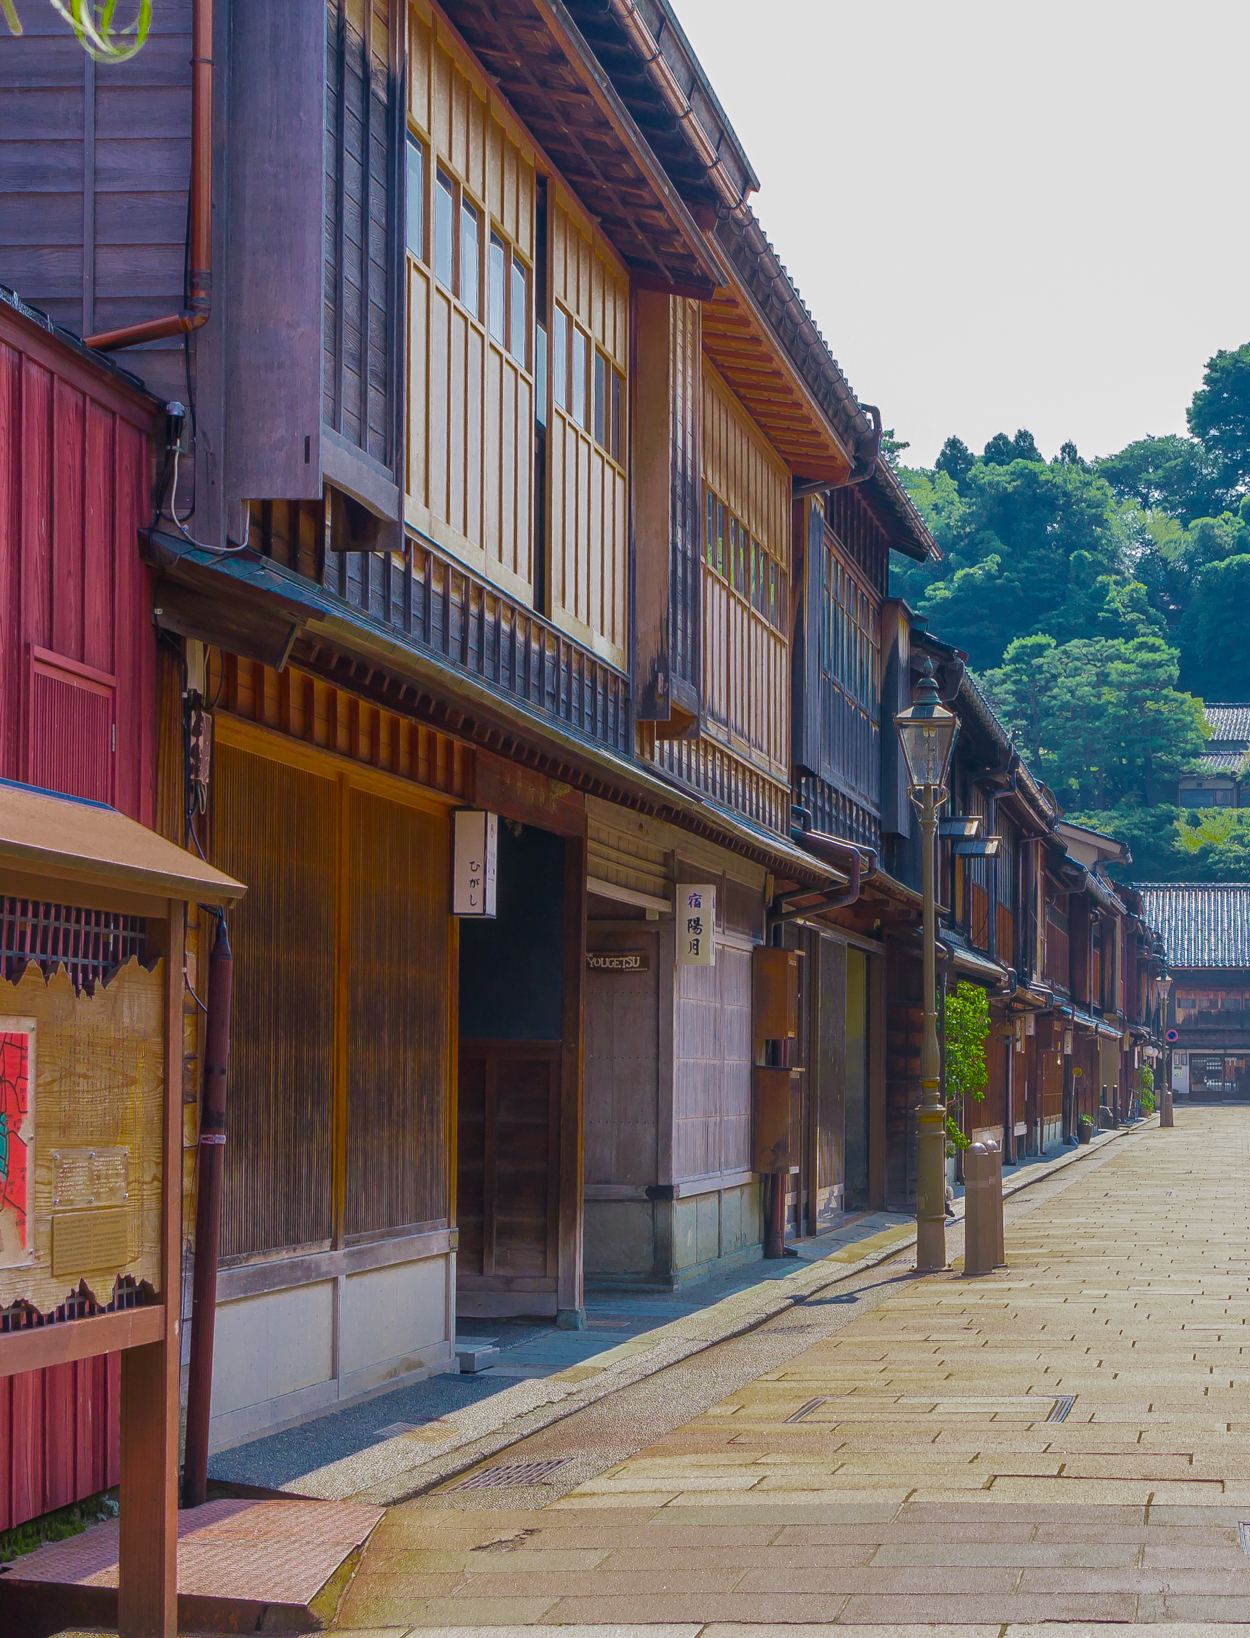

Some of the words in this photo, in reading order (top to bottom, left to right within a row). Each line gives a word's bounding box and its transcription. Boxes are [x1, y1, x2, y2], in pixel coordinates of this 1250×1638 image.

[469, 861, 480, 906] ひがし
[587, 956, 640, 968] YOUGETSU
